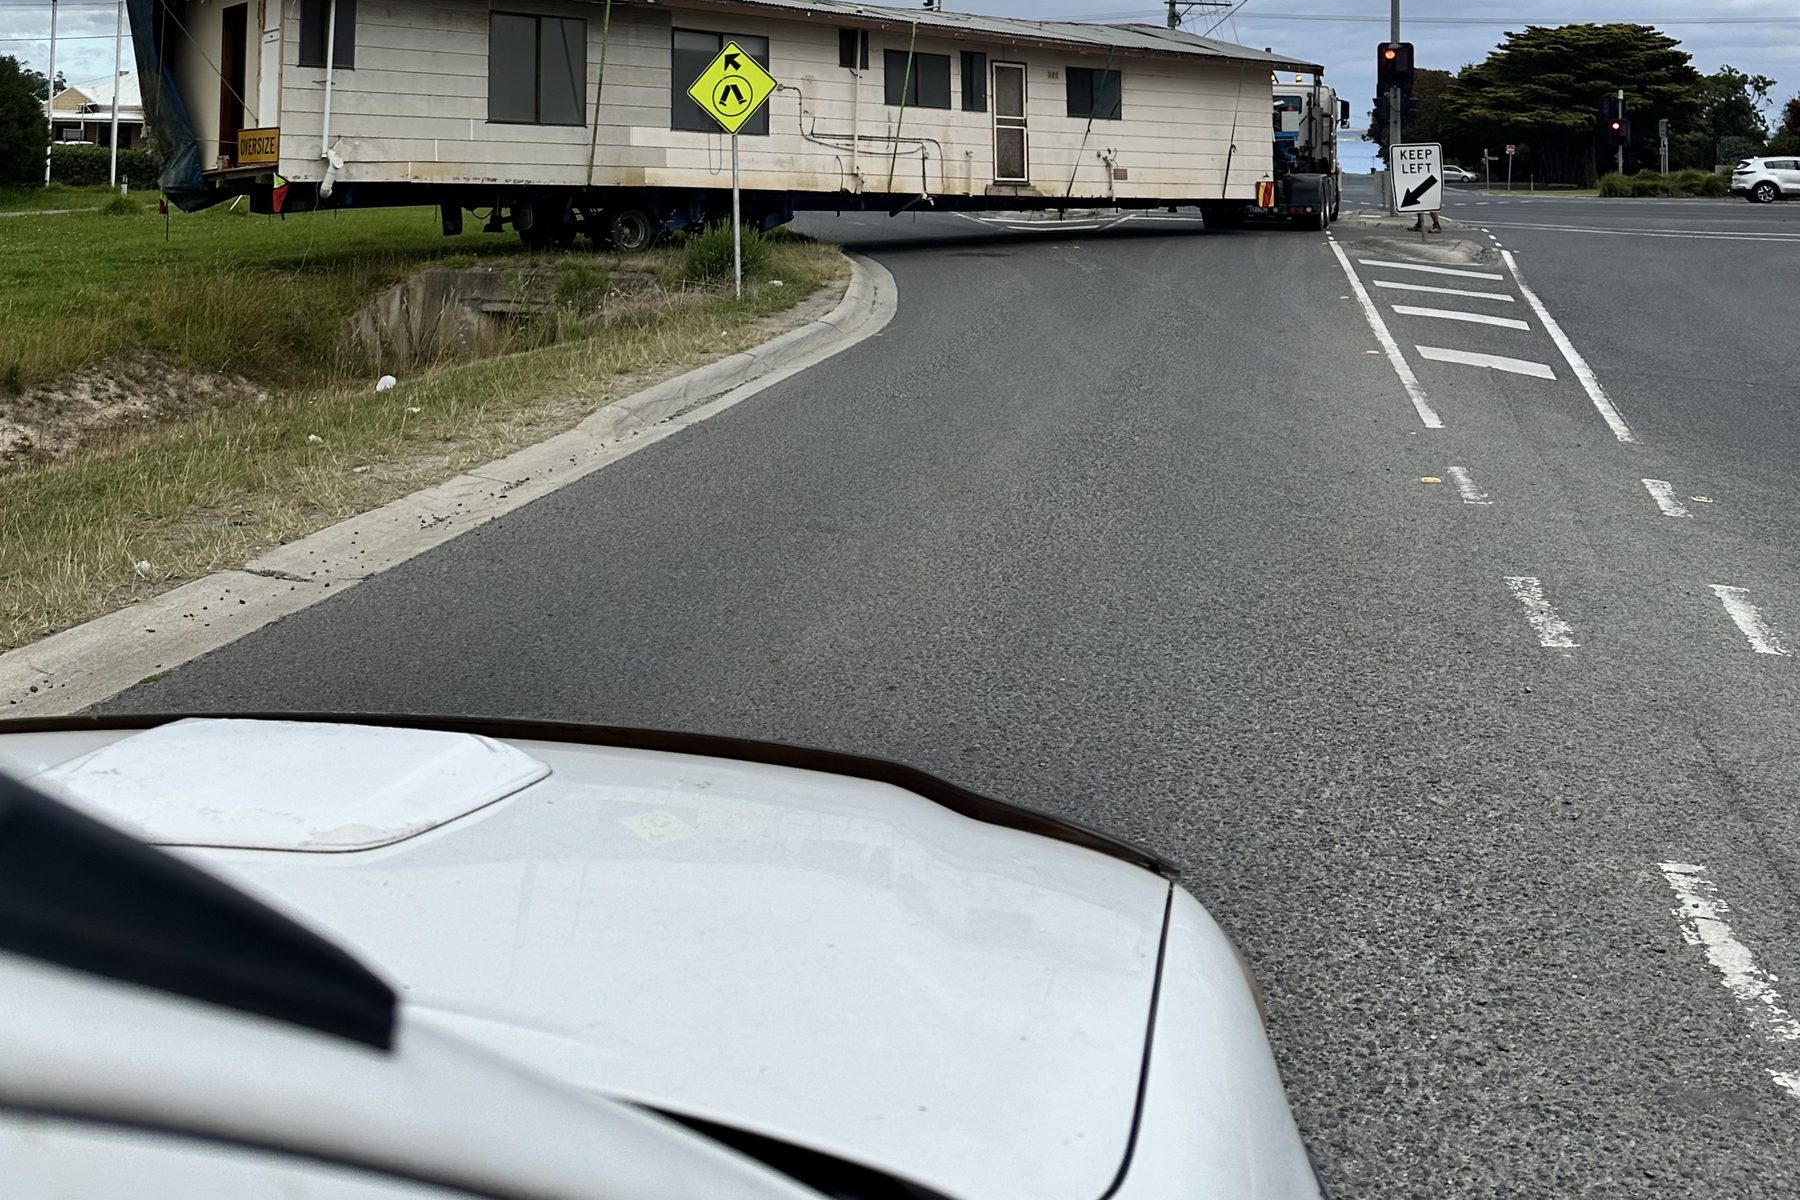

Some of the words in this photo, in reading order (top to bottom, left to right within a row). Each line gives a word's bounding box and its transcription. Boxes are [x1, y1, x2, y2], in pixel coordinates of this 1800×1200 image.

[240, 137, 276, 156] OVERSIZE
[1400, 149, 1433, 160] KEEP
[1402, 163, 1432, 174] LEFT
